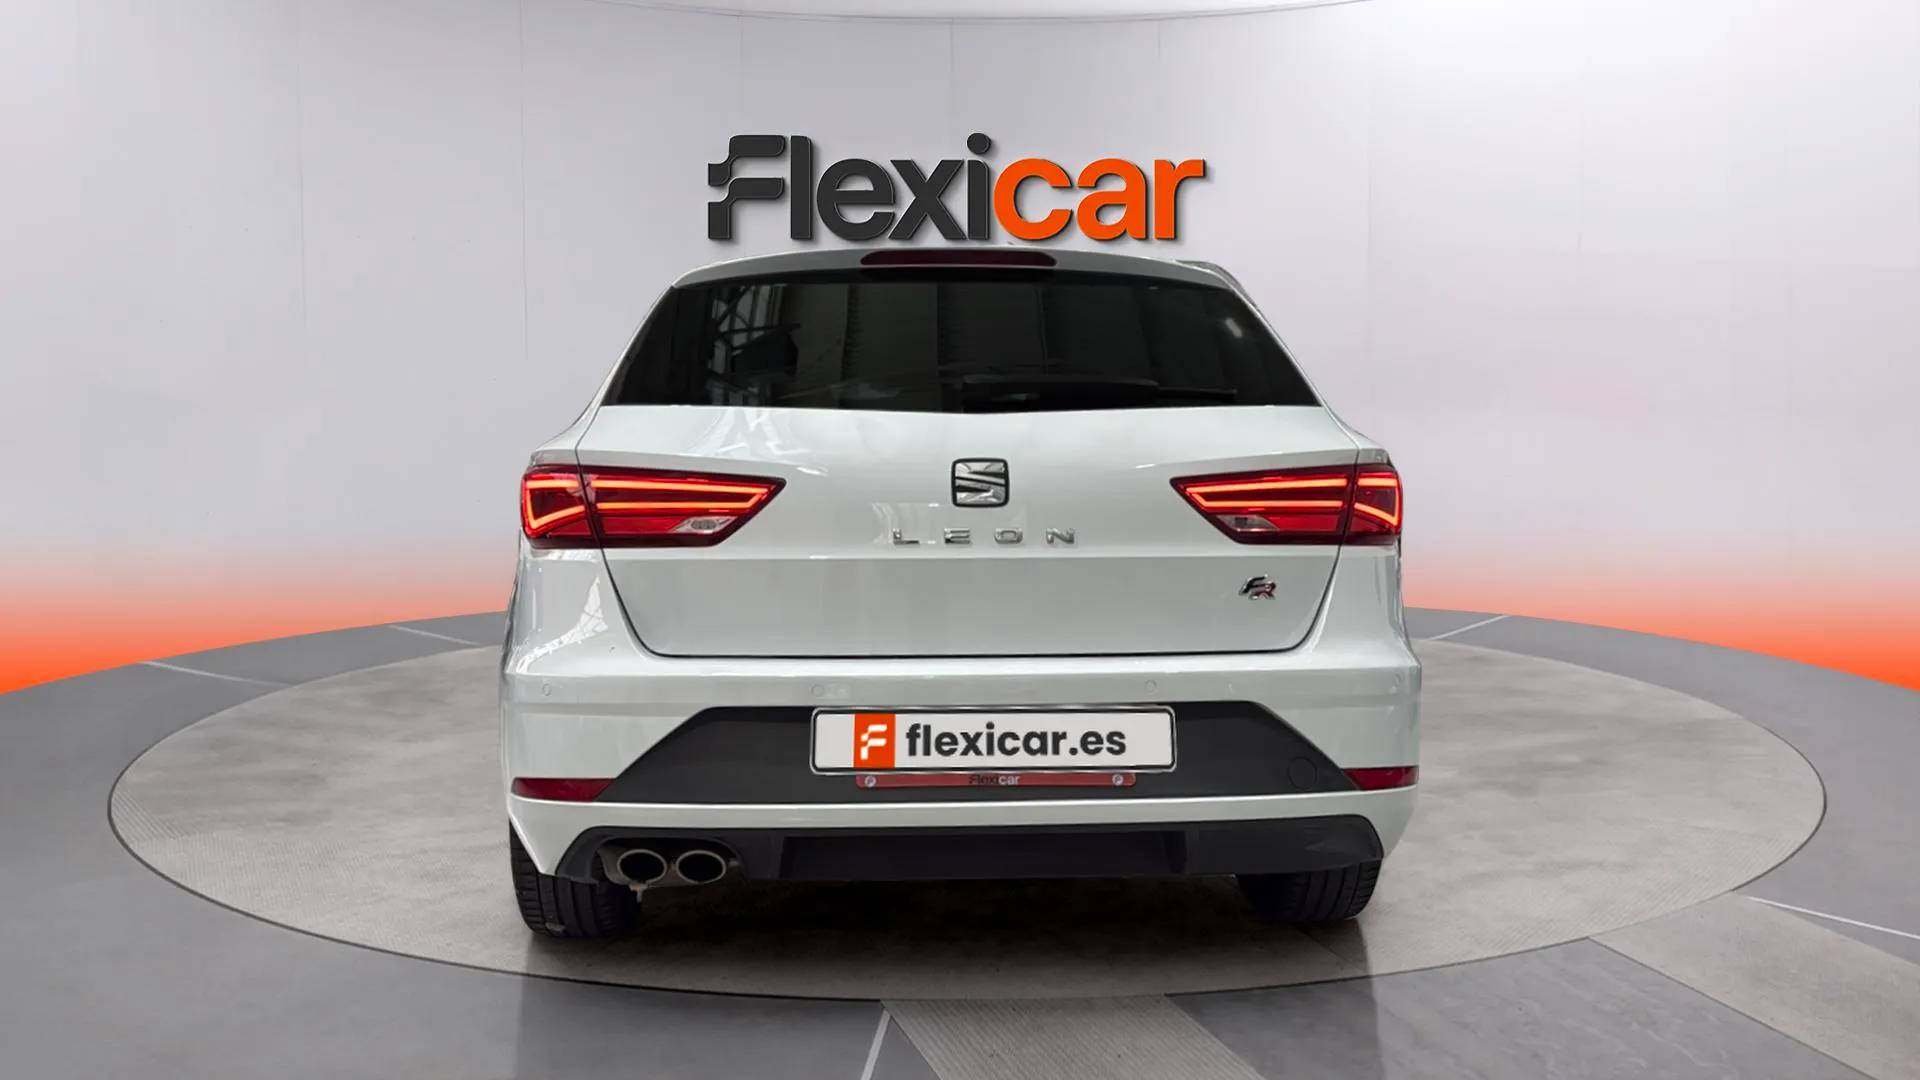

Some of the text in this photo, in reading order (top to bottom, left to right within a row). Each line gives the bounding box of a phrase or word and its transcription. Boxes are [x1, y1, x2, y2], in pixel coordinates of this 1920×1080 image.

[708, 132, 1205, 241] Flexicar
[893, 527, 1075, 545] LEON
[1239, 574, 1276, 601] FR
[905, 721, 1127, 757] flexicar.es
